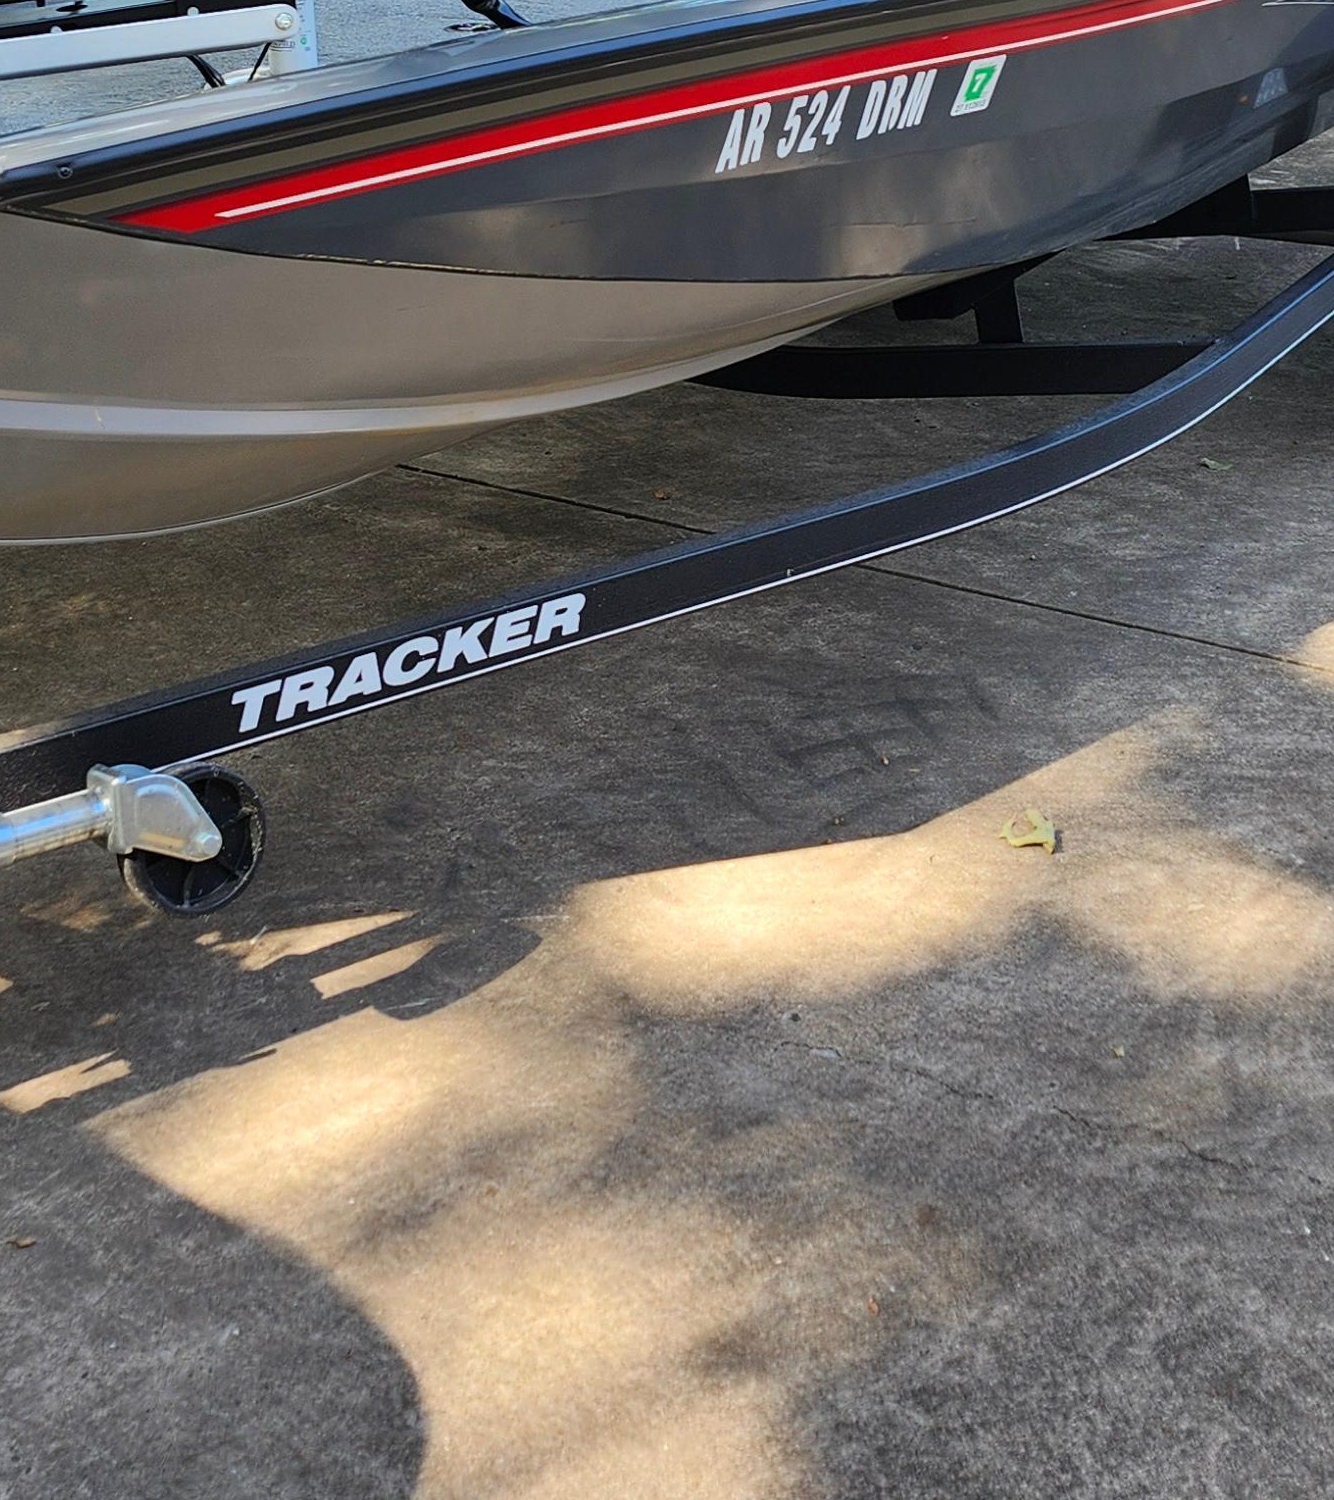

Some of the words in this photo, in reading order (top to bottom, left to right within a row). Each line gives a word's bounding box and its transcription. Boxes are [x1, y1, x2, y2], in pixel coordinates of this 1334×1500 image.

[715, 101, 772, 173] AR
[776, 85, 851, 159] 524
[856, 68, 938, 140] DRM
[231, 592, 586, 733] TRACKER
